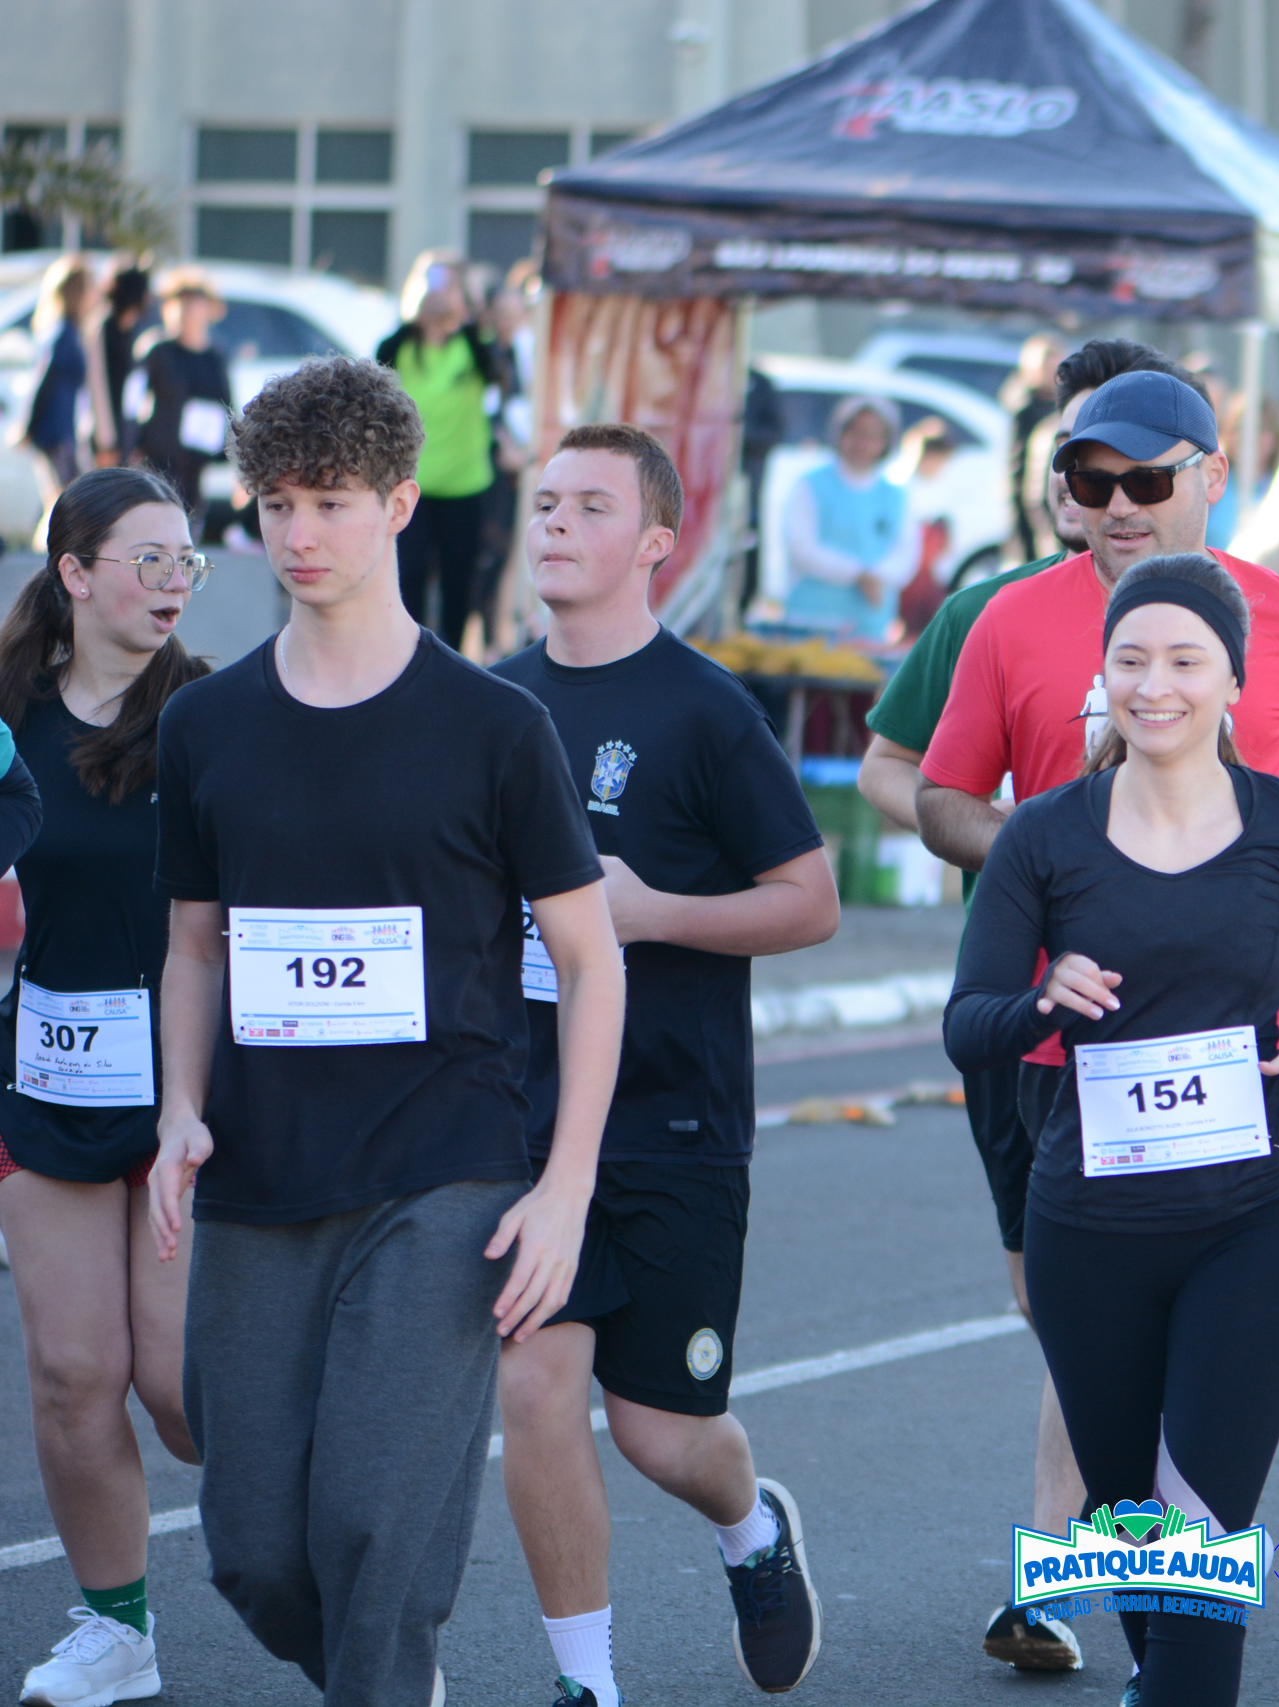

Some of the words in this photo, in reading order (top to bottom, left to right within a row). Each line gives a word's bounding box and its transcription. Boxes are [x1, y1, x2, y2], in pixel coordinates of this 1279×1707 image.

[587, 800, 620, 816] BRASIL
[372, 937, 398, 945] CAUSA
[286, 957, 366, 988] 192
[104, 1008, 126, 1016] CAUSA
[40, 1021, 99, 1052] 307
[1208, 1052, 1234, 1061] CAUSA
[1127, 1074, 1208, 1113] 154
